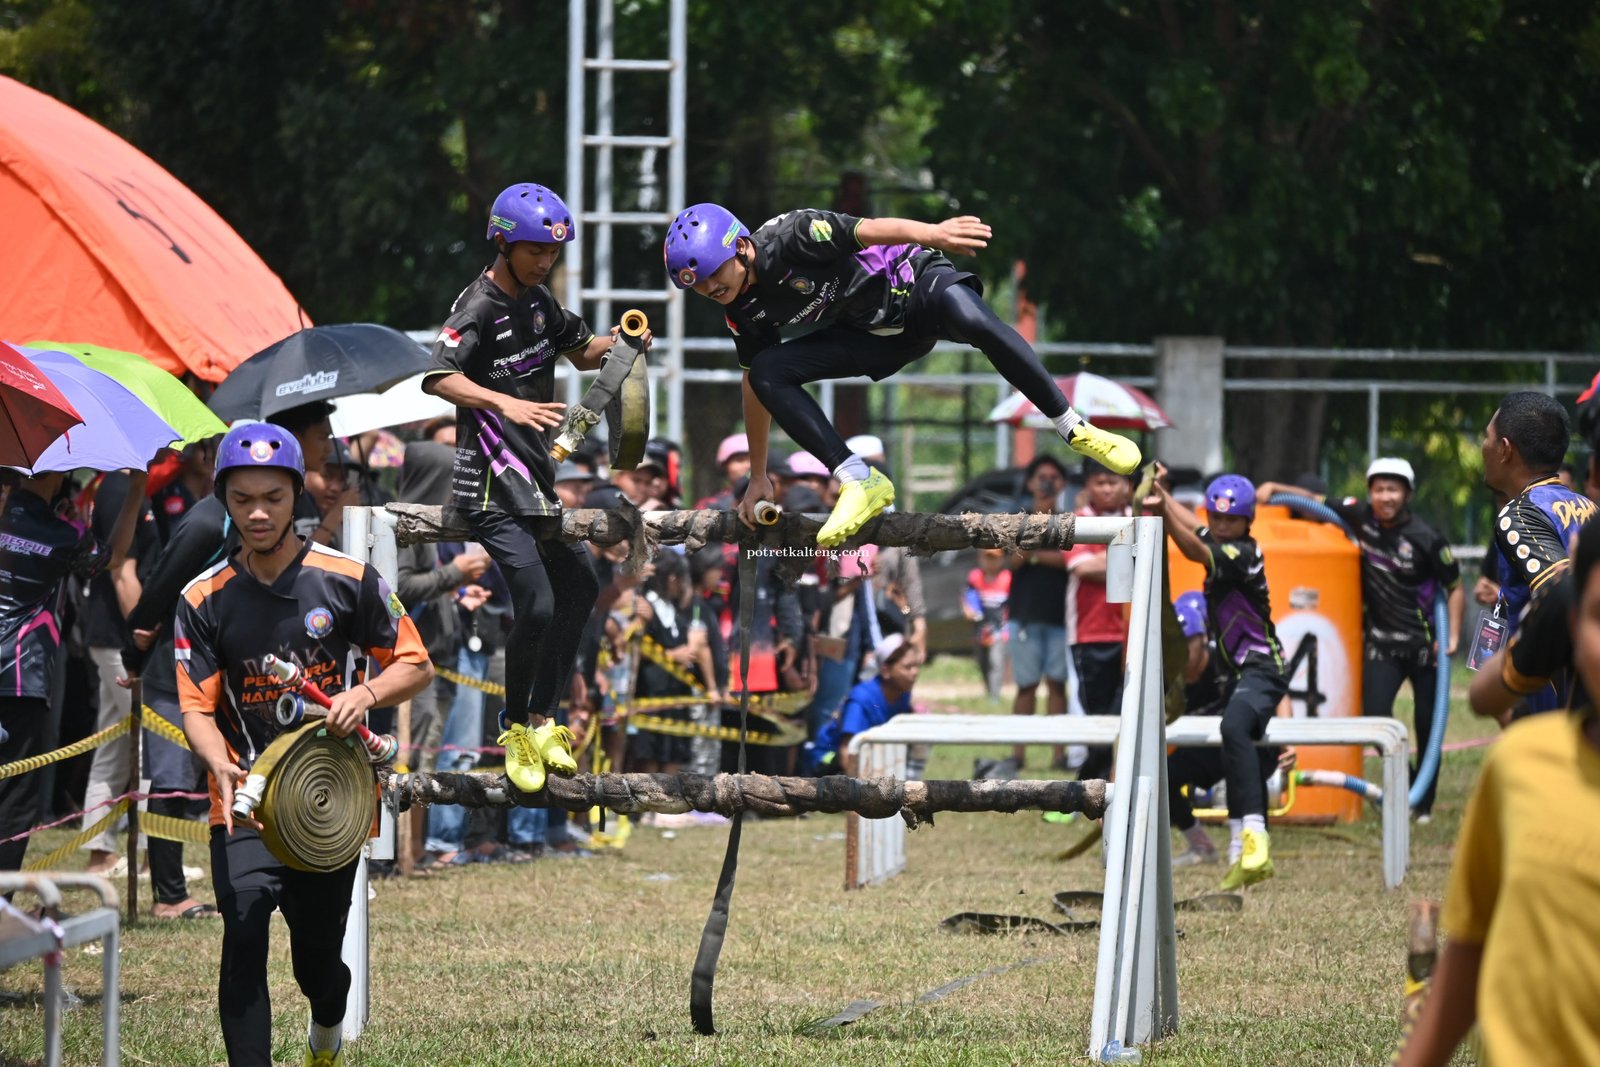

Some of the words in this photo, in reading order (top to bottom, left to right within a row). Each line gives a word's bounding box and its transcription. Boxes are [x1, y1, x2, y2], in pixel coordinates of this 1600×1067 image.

[800, 298, 822, 318] HANTU
[461, 466, 483, 475] FAMILY
[243, 660, 337, 688] PEMRU
[1282, 631, 1327, 718] 4
